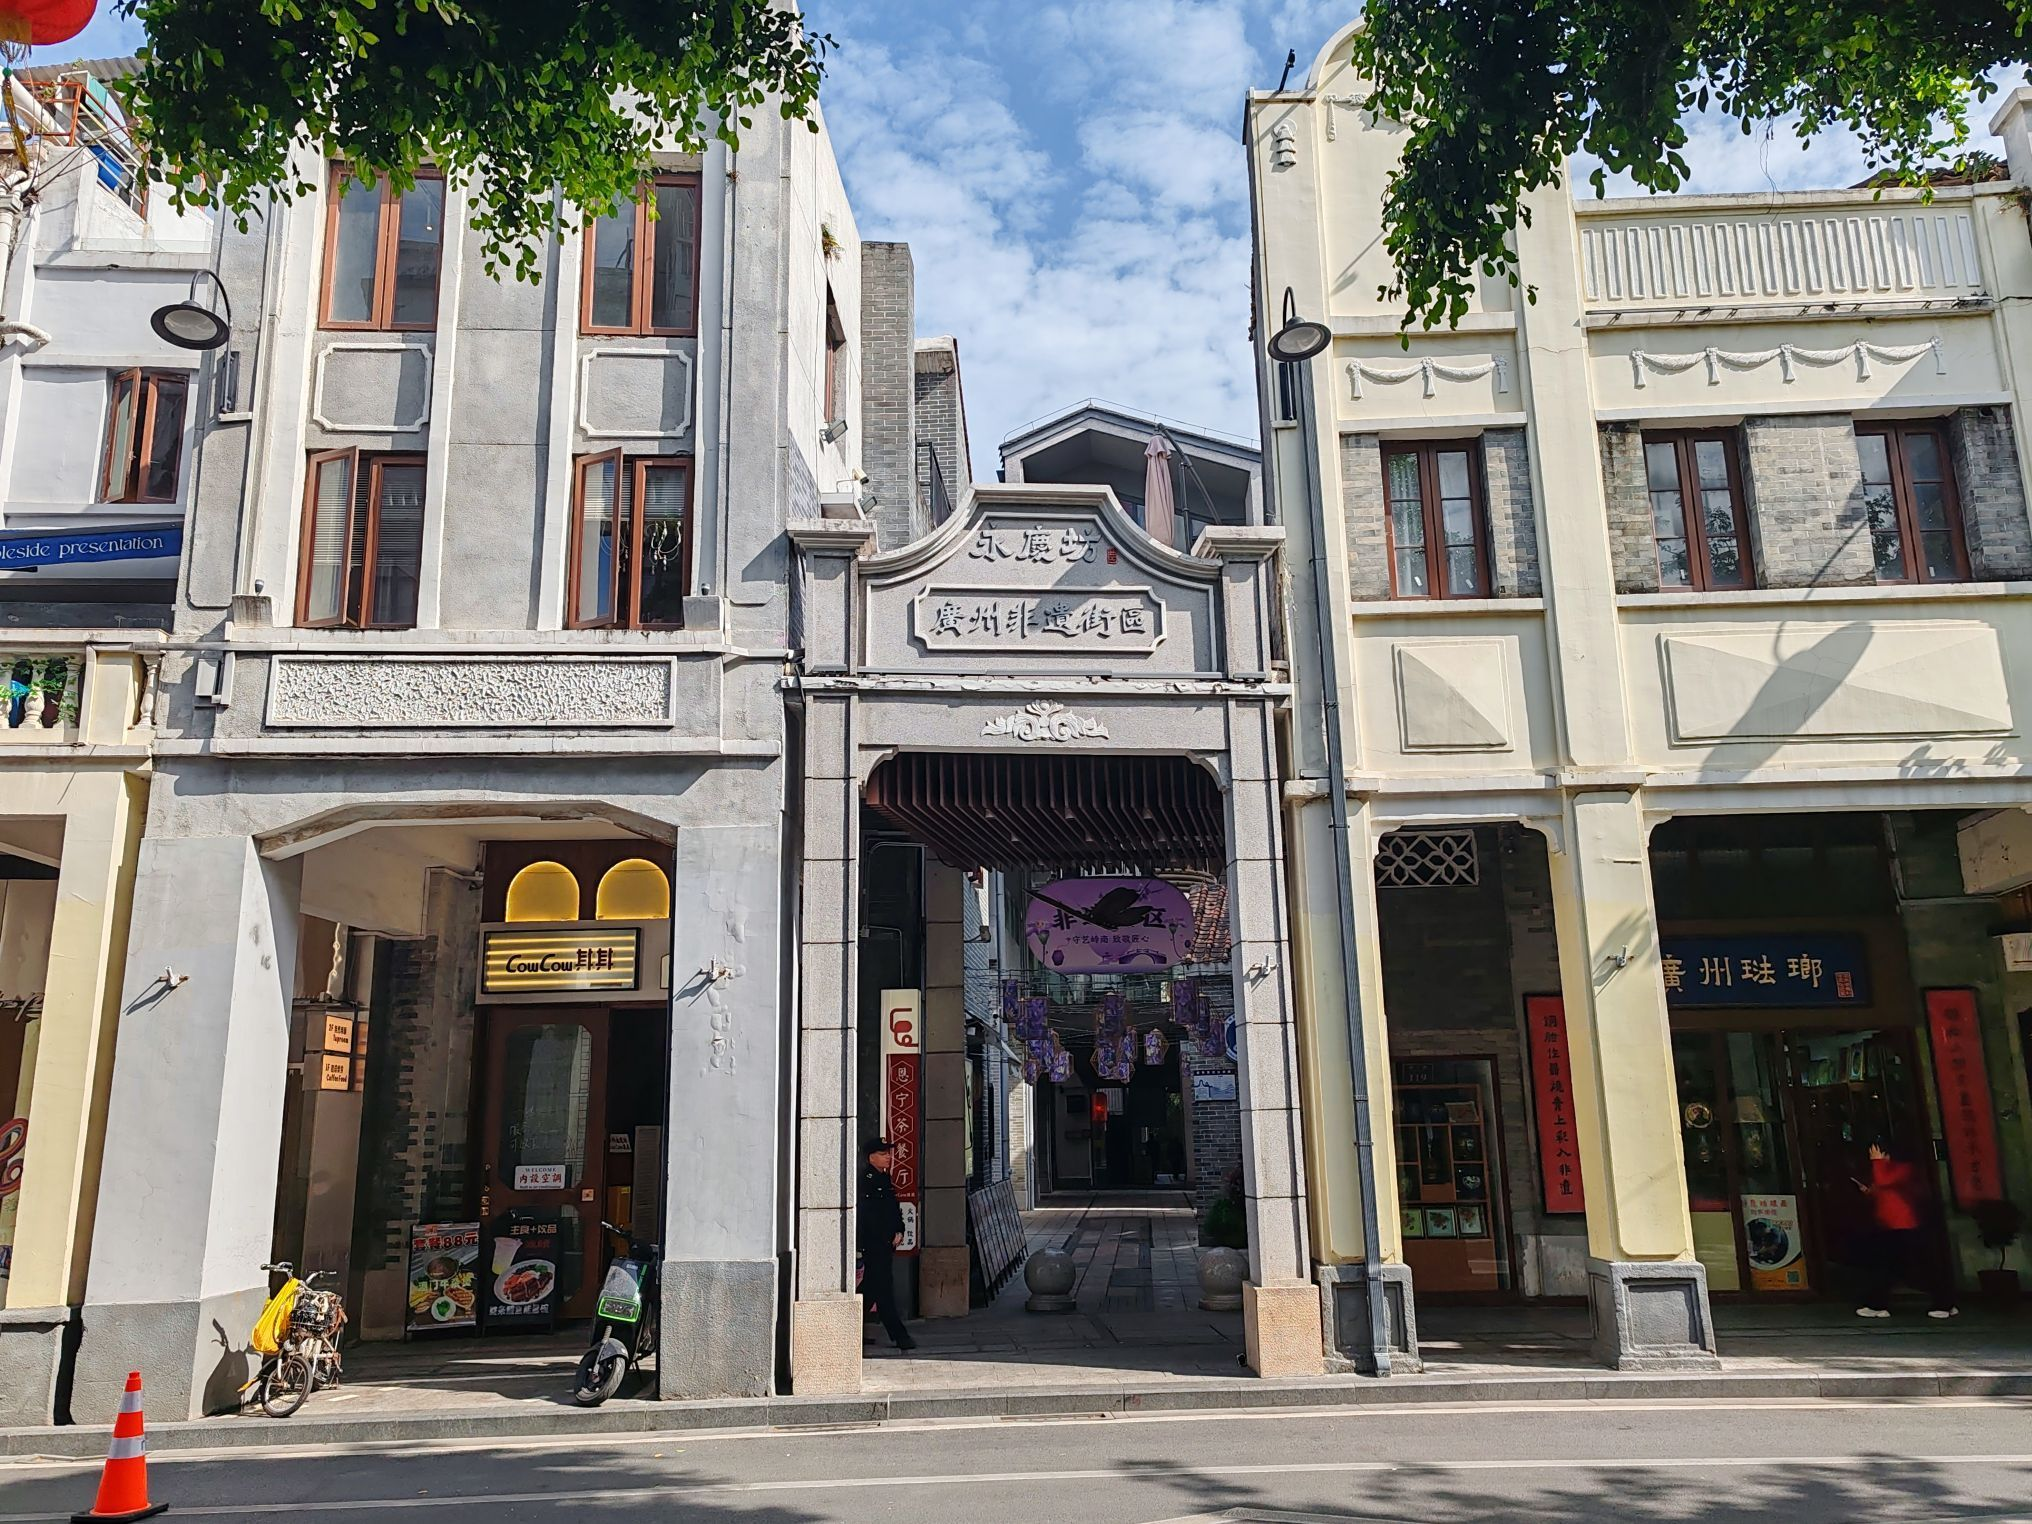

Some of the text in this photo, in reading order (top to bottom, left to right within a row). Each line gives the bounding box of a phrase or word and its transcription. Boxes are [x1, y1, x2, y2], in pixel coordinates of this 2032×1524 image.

[0, 537, 163, 559] leside presentation
[930, 601, 1146, 639] 廣州非遺街區
[1053, 908, 1166, 930] 非区
[506, 953, 573, 973] CowCow
[896, 1067, 910, 1187] 恩宁茶餐厅
[510, 1224, 557, 1235] 主食+饮品
